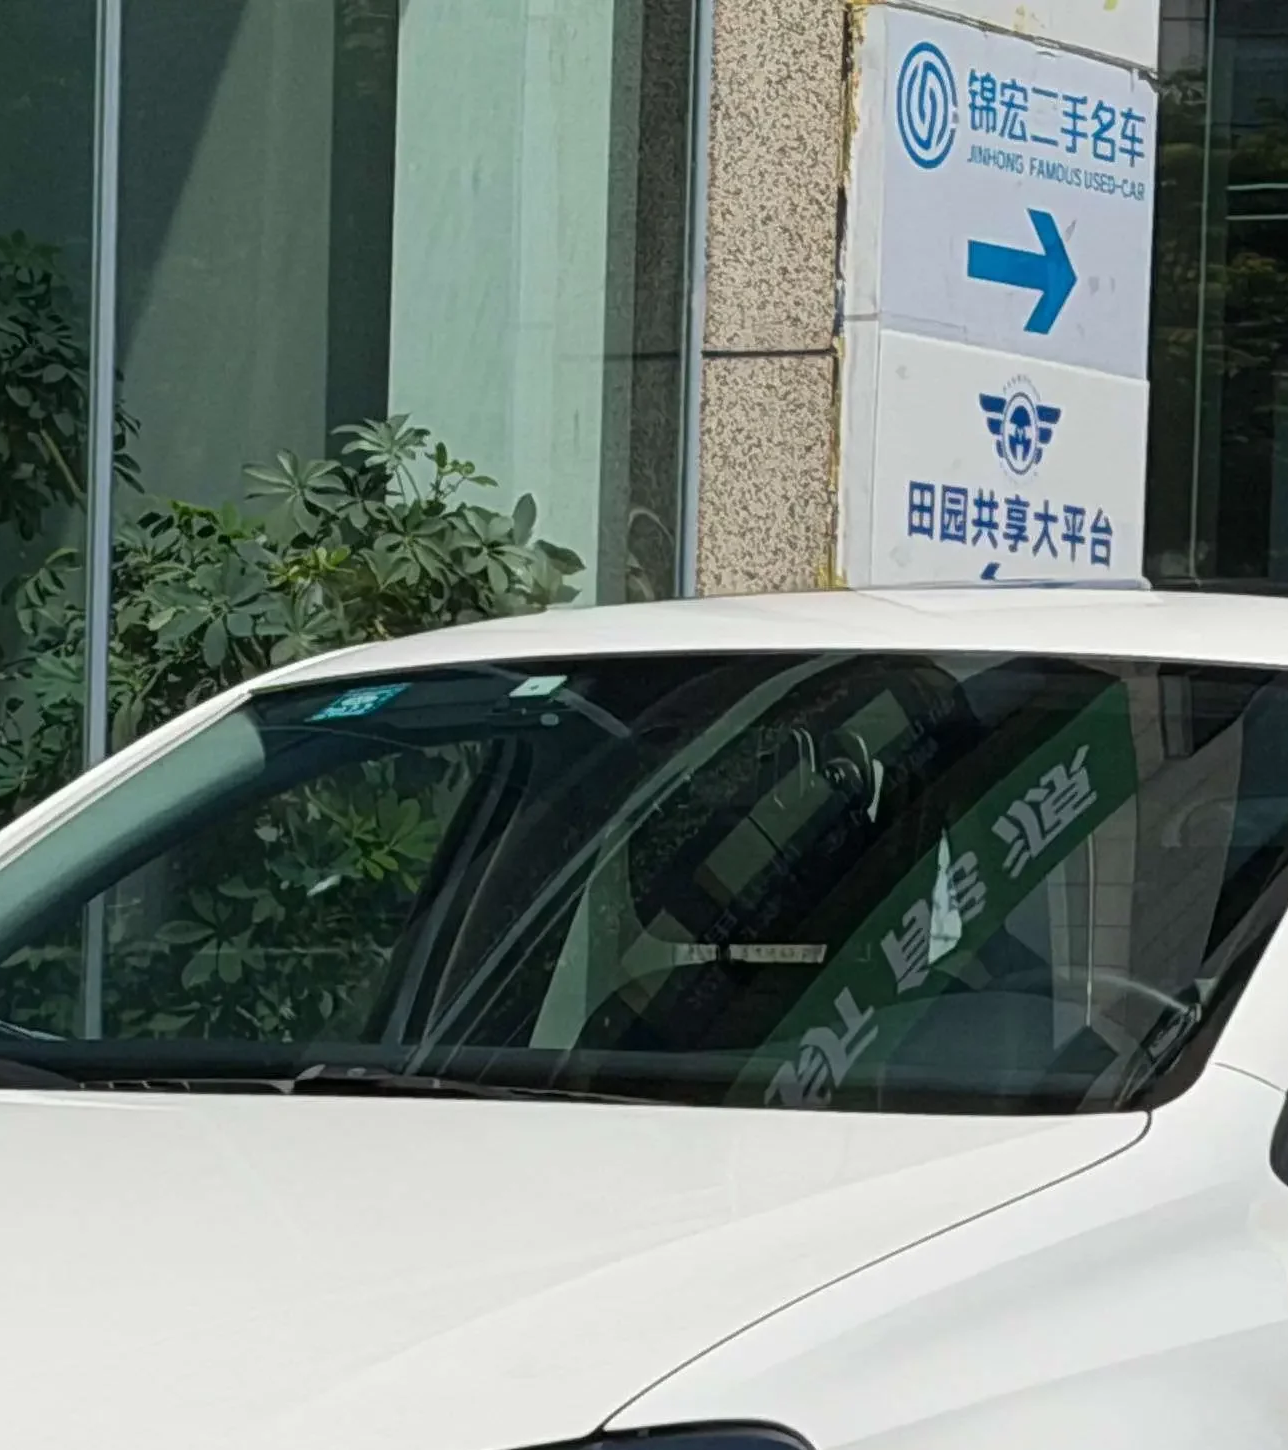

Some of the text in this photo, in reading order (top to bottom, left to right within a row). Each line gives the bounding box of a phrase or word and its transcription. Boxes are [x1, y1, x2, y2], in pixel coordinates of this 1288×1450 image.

[967, 68, 1146, 168] 锦宏二手名车
[967, 144, 1146, 201] JINHONG FAMOUS USED-CAR
[907, 480, 1113, 569] 田园共享大平台
